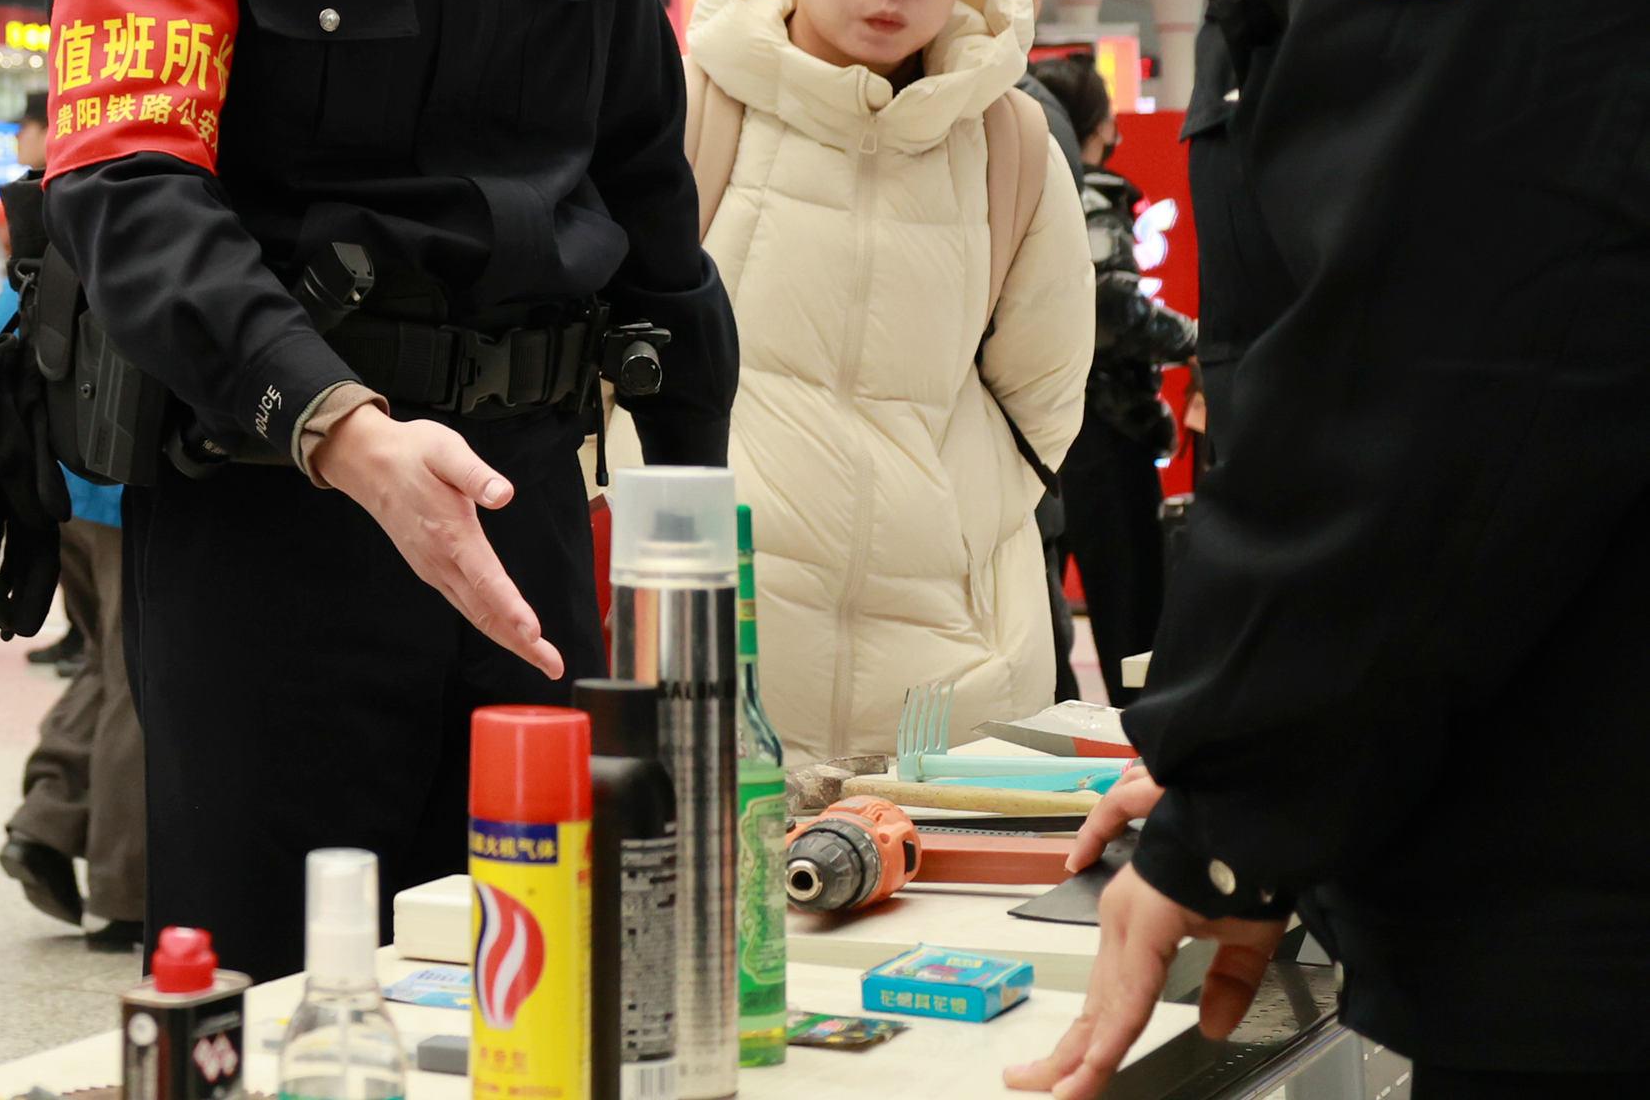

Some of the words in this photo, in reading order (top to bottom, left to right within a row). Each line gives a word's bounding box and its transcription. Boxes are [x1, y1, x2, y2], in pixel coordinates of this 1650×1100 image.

[54, 94, 218, 150] 贵阳铁路公安
